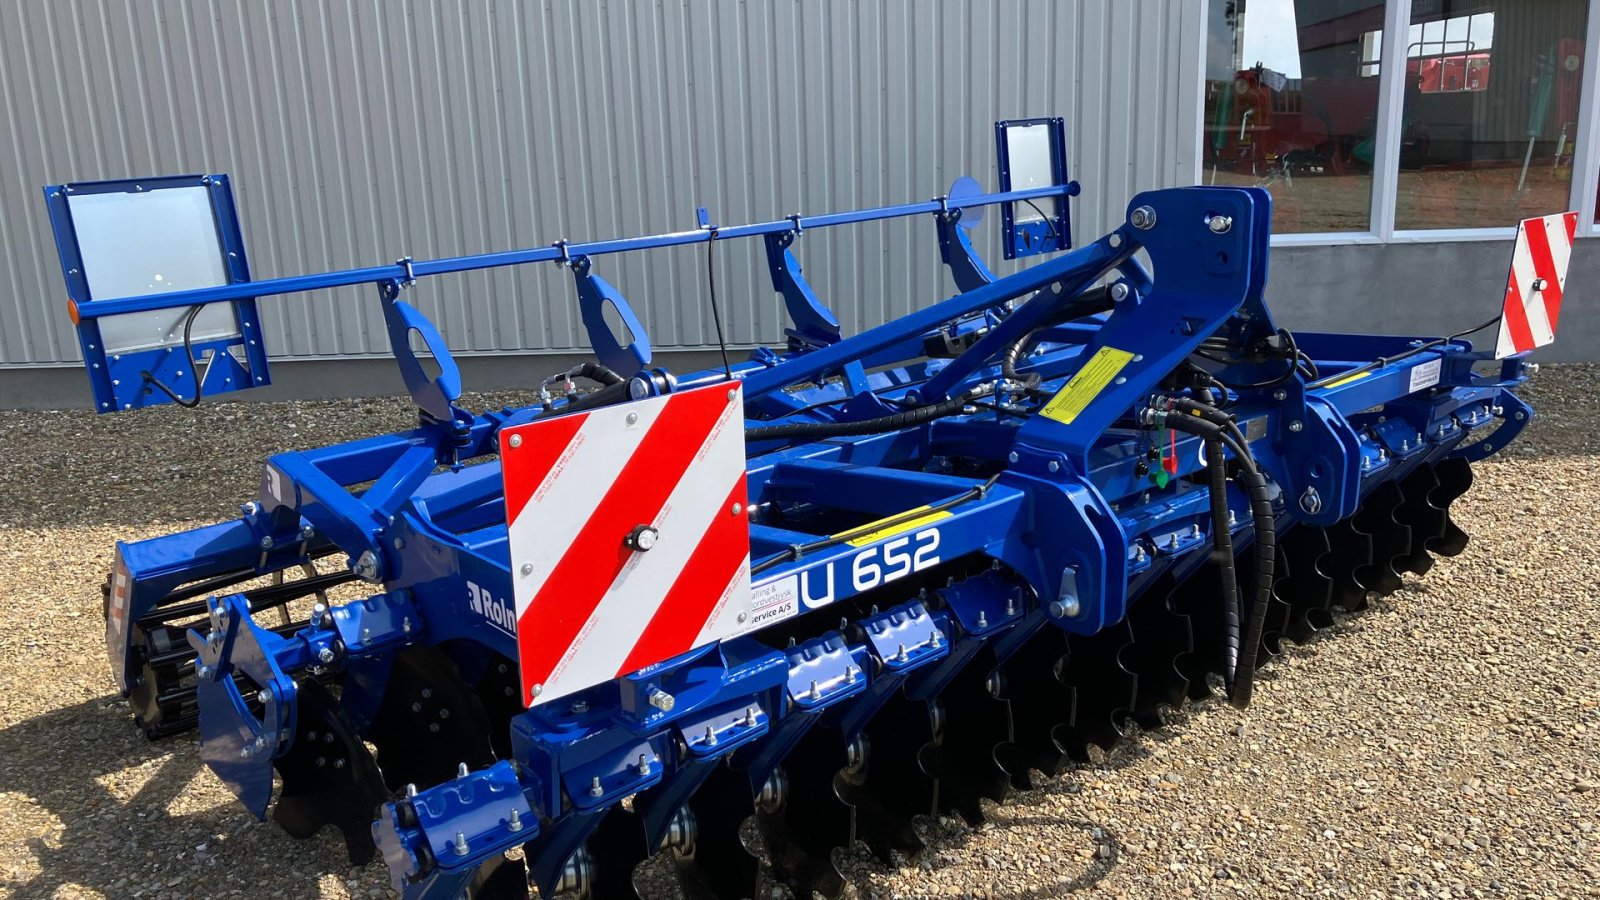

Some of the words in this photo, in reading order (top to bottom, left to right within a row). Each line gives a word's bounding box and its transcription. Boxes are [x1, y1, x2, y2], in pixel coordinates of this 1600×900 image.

[801, 562, 835, 609] U
[853, 528, 940, 592] 652
[771, 585, 776, 593] &
[778, 602, 792, 614] A/S
